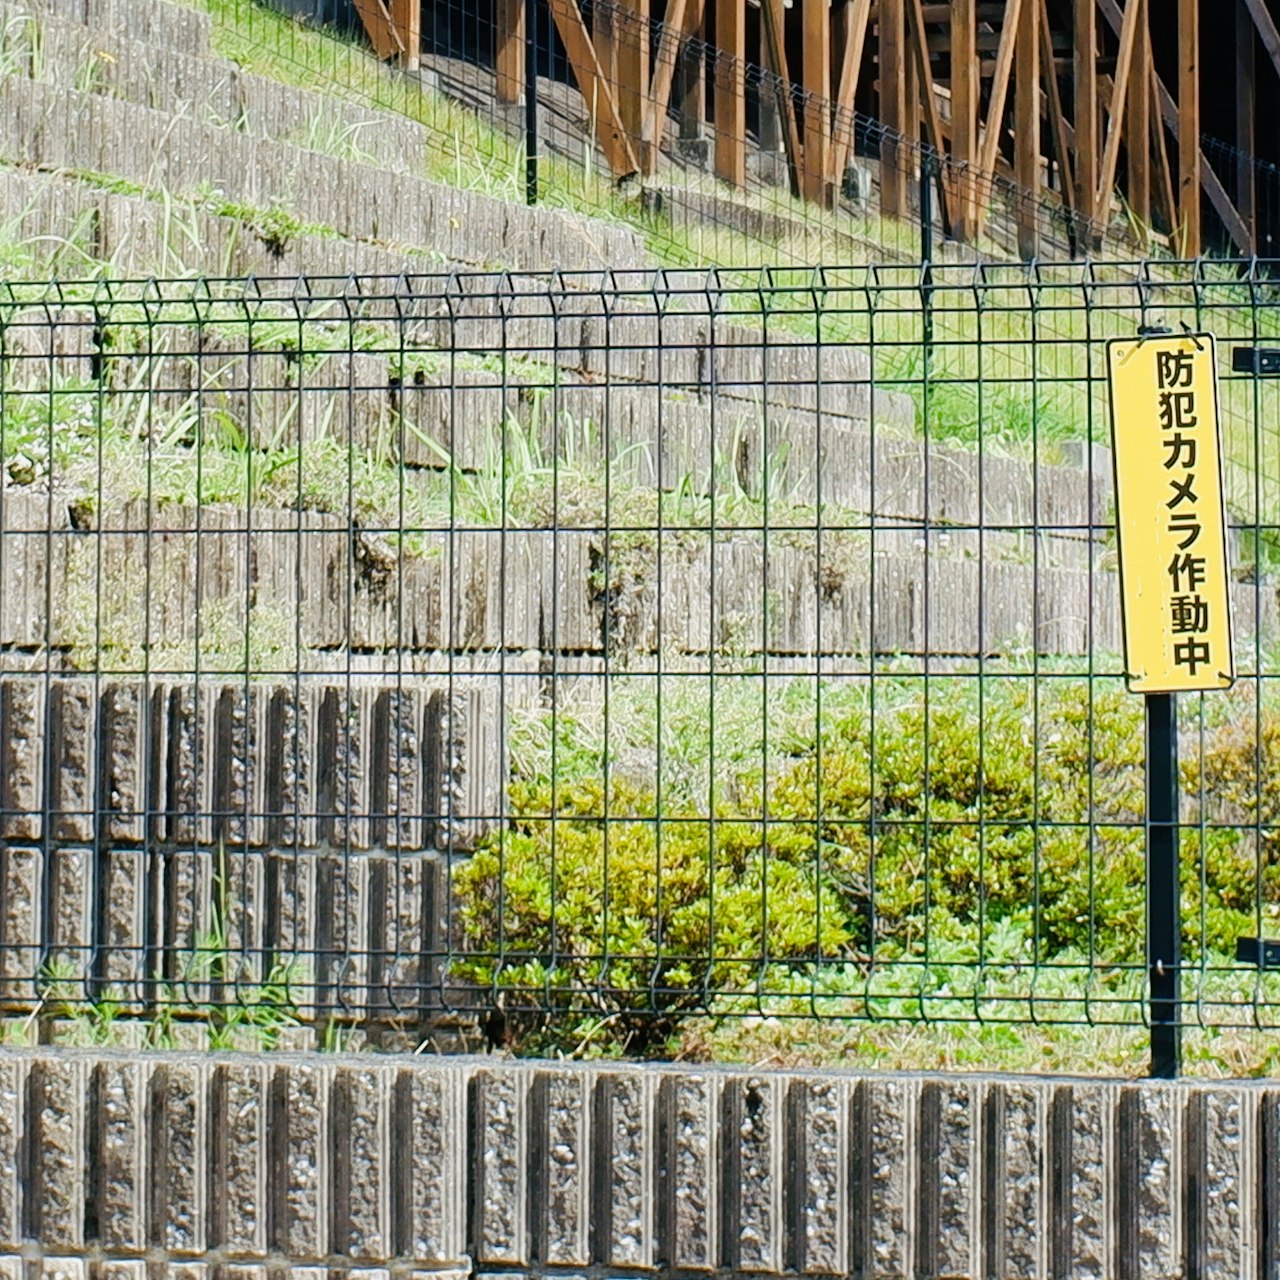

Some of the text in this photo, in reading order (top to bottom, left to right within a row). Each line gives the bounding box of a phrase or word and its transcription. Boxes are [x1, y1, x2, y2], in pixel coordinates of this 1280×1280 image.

[1156, 349, 1210, 676] 防犯カメラ作動中
